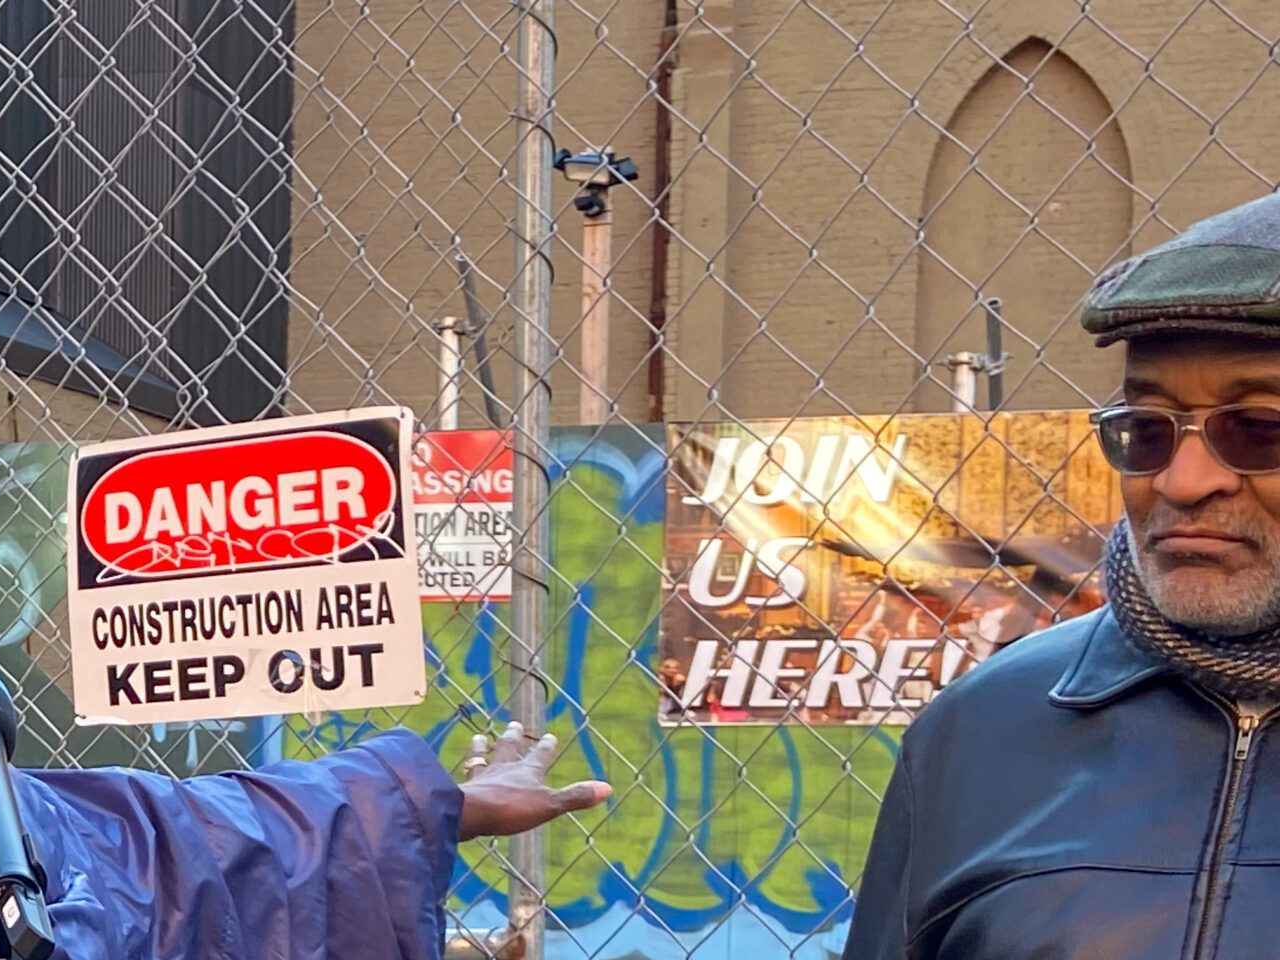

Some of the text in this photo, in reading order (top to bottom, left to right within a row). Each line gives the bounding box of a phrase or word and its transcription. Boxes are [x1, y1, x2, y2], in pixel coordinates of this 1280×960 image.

[681, 433, 907, 506] JOIN
[104, 466, 366, 544] DANGER
[418, 572, 475, 588] UTED
[426, 551, 476, 567] WILL
[688, 536, 814, 607] US
[91, 581, 396, 651] CONSTRUCTION AREA
[107, 643, 385, 707] KEEP OUT
[681, 638, 968, 709] HERE!
